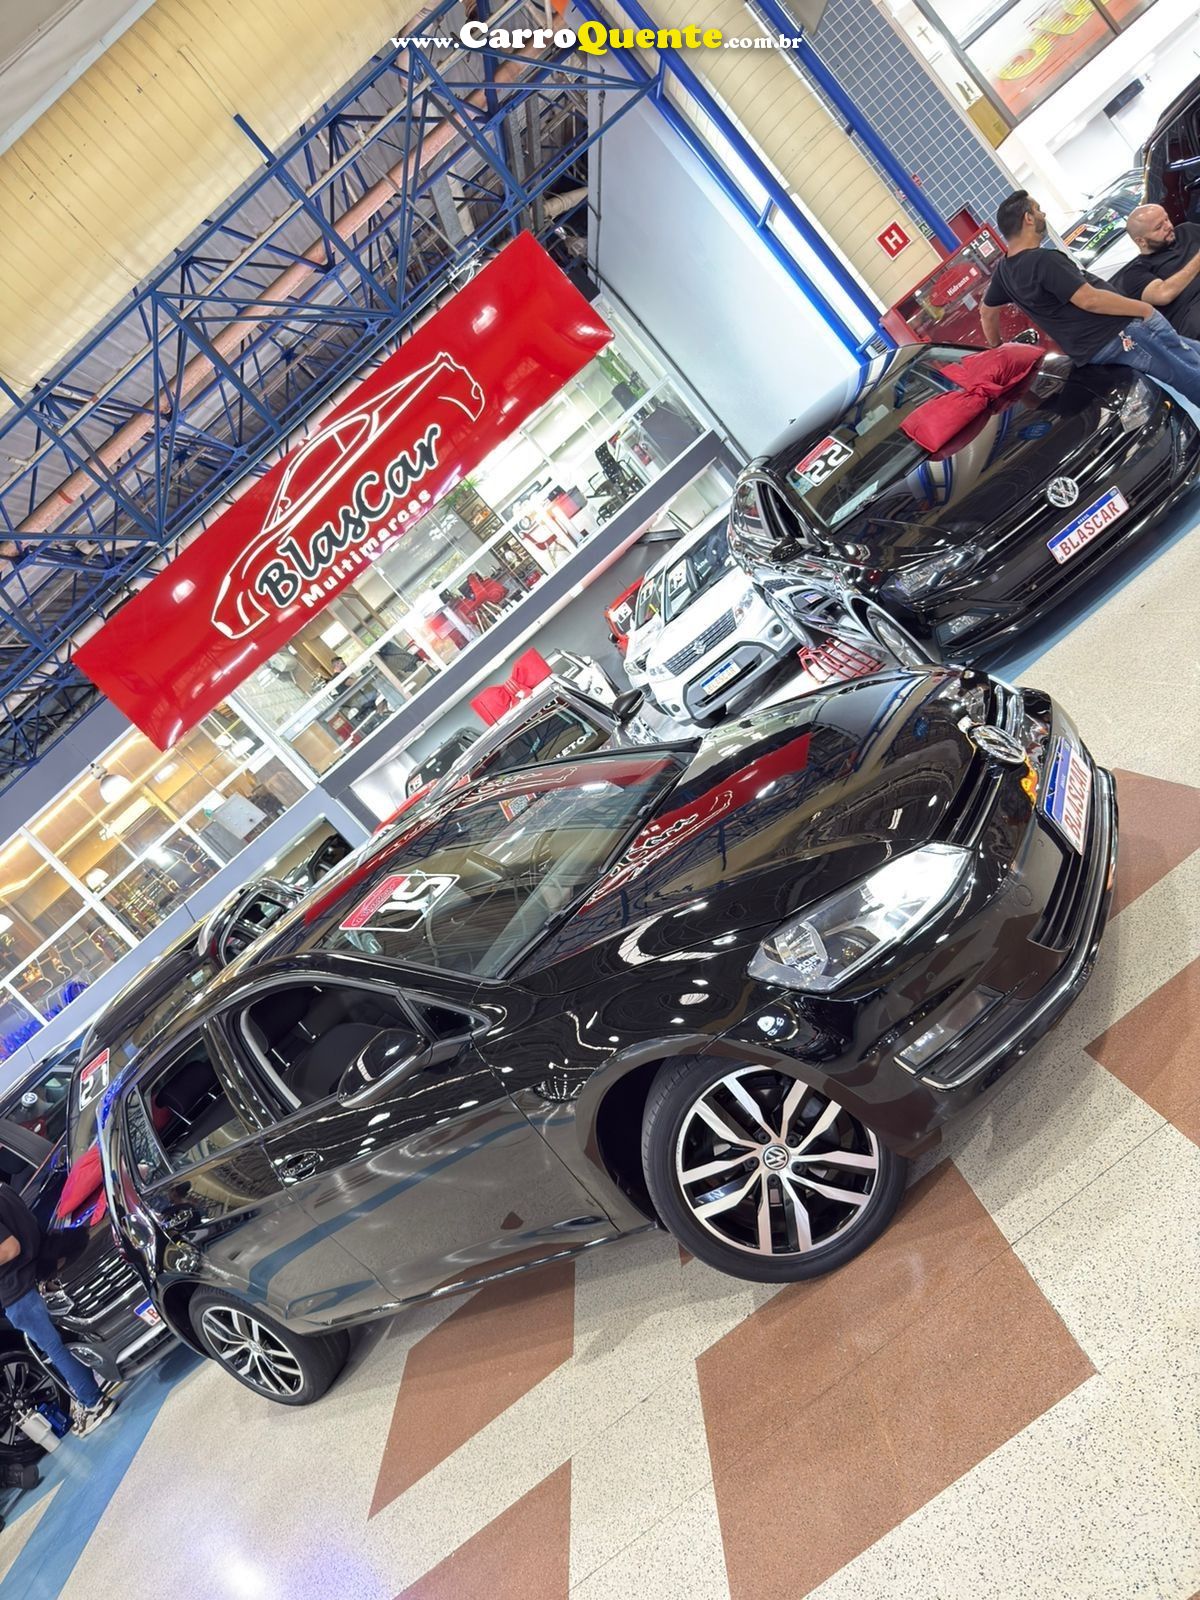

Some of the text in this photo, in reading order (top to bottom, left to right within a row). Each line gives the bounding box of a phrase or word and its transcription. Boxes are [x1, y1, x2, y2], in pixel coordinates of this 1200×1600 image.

[884, 229, 904, 251] H
[970, 230, 991, 250] H 19
[946, 276, 970, 296] Hidrante
[806, 443, 850, 484] 22
[255, 424, 442, 608] BlasCar
[1059, 501, 1120, 557] BLASCAR
[301, 489, 432, 608] Multimarcas
[1064, 758, 1088, 840] BLASCAR
[81, 1062, 107, 1106] 21
